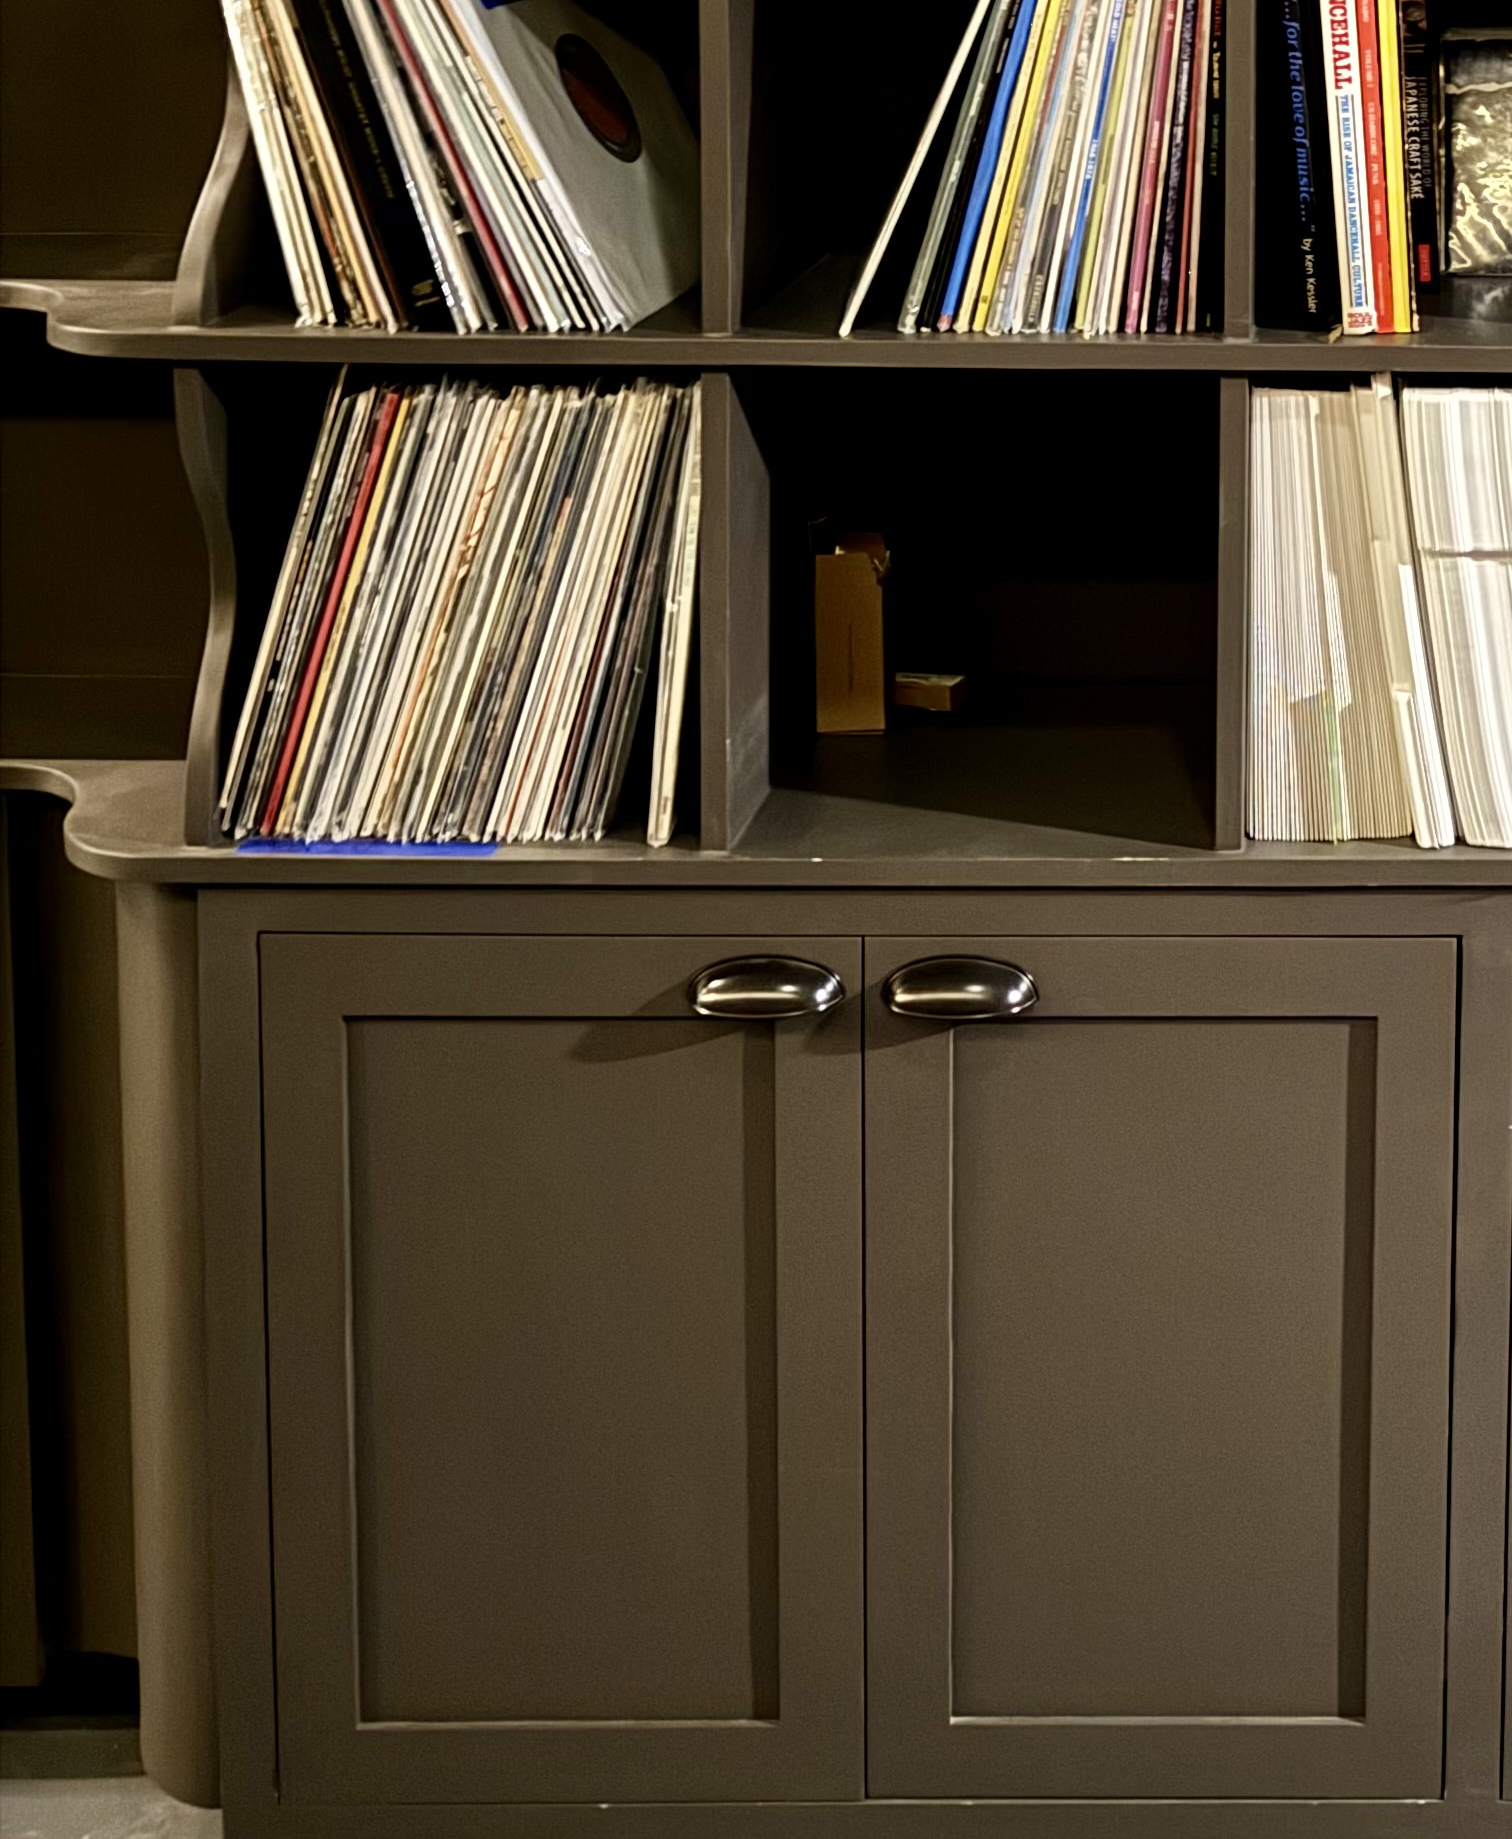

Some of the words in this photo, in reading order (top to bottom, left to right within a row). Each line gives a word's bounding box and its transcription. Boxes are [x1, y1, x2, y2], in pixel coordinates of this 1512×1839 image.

[1287, 50, 1304, 81] the
[1290, 84, 1307, 124] love
[1341, 96, 1349, 112] THE
[1405, 77, 1418, 132] JAPANESE
[1291, 125, 1309, 148] of
[1342, 117, 1350, 137] RISE
[1344, 141, 1351, 151] OF
[1408, 136, 1421, 169] CRAFT
[1421, 144, 1431, 174] WORLD
[1345, 155, 1355, 203] JAMAICAN
[1424, 178, 1431, 187] OF
[1300, 237, 1314, 251] by
[1349, 207, 1359, 262] DANCEHALL
[1304, 254, 1315, 274] Ken
[1305, 277, 1318, 313] Kessler
[1353, 265, 1362, 306] CULTURE
